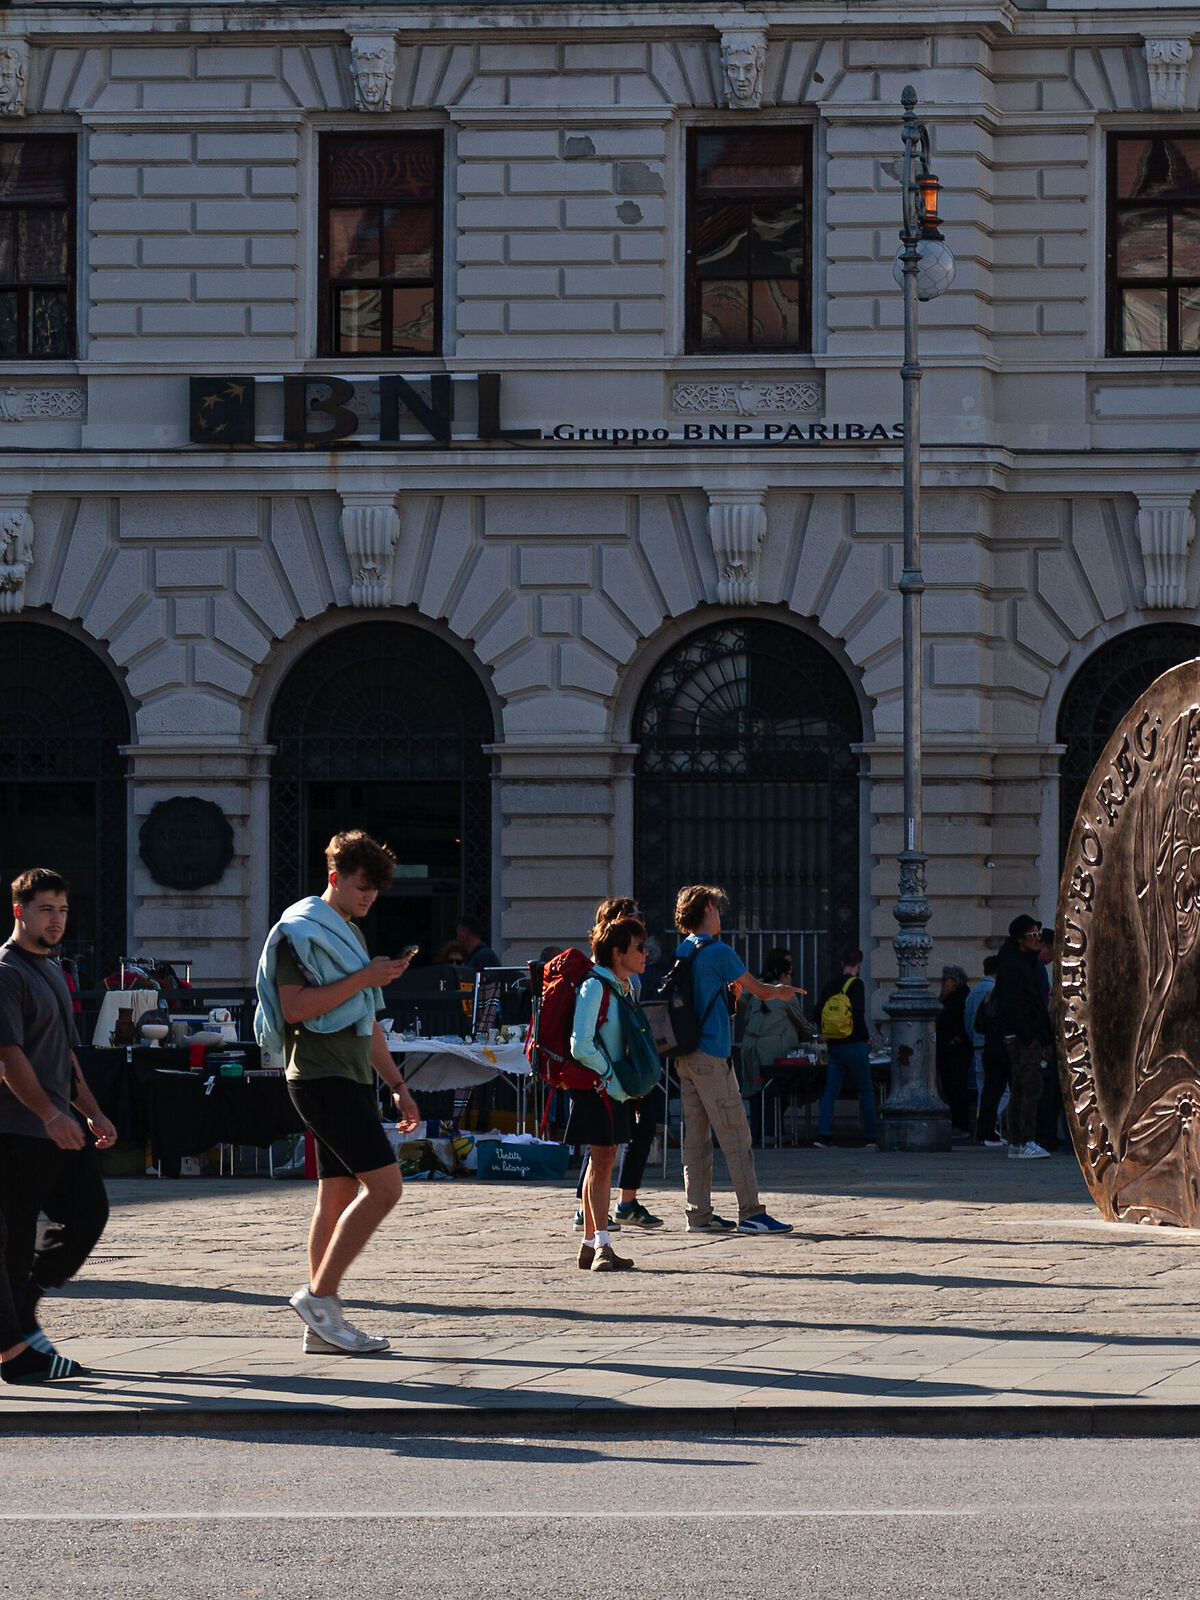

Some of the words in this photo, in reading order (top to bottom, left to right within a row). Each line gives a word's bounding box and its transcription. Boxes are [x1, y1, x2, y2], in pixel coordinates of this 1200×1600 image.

[284, 373, 542, 442] BNL
[553, 424, 669, 445] Gruppo
[684, 424, 753, 440] BNP
[765, 423, 905, 440] PARIBAS
[491, 1163, 501, 1171] in
[502, 1160, 531, 1177] letargo
